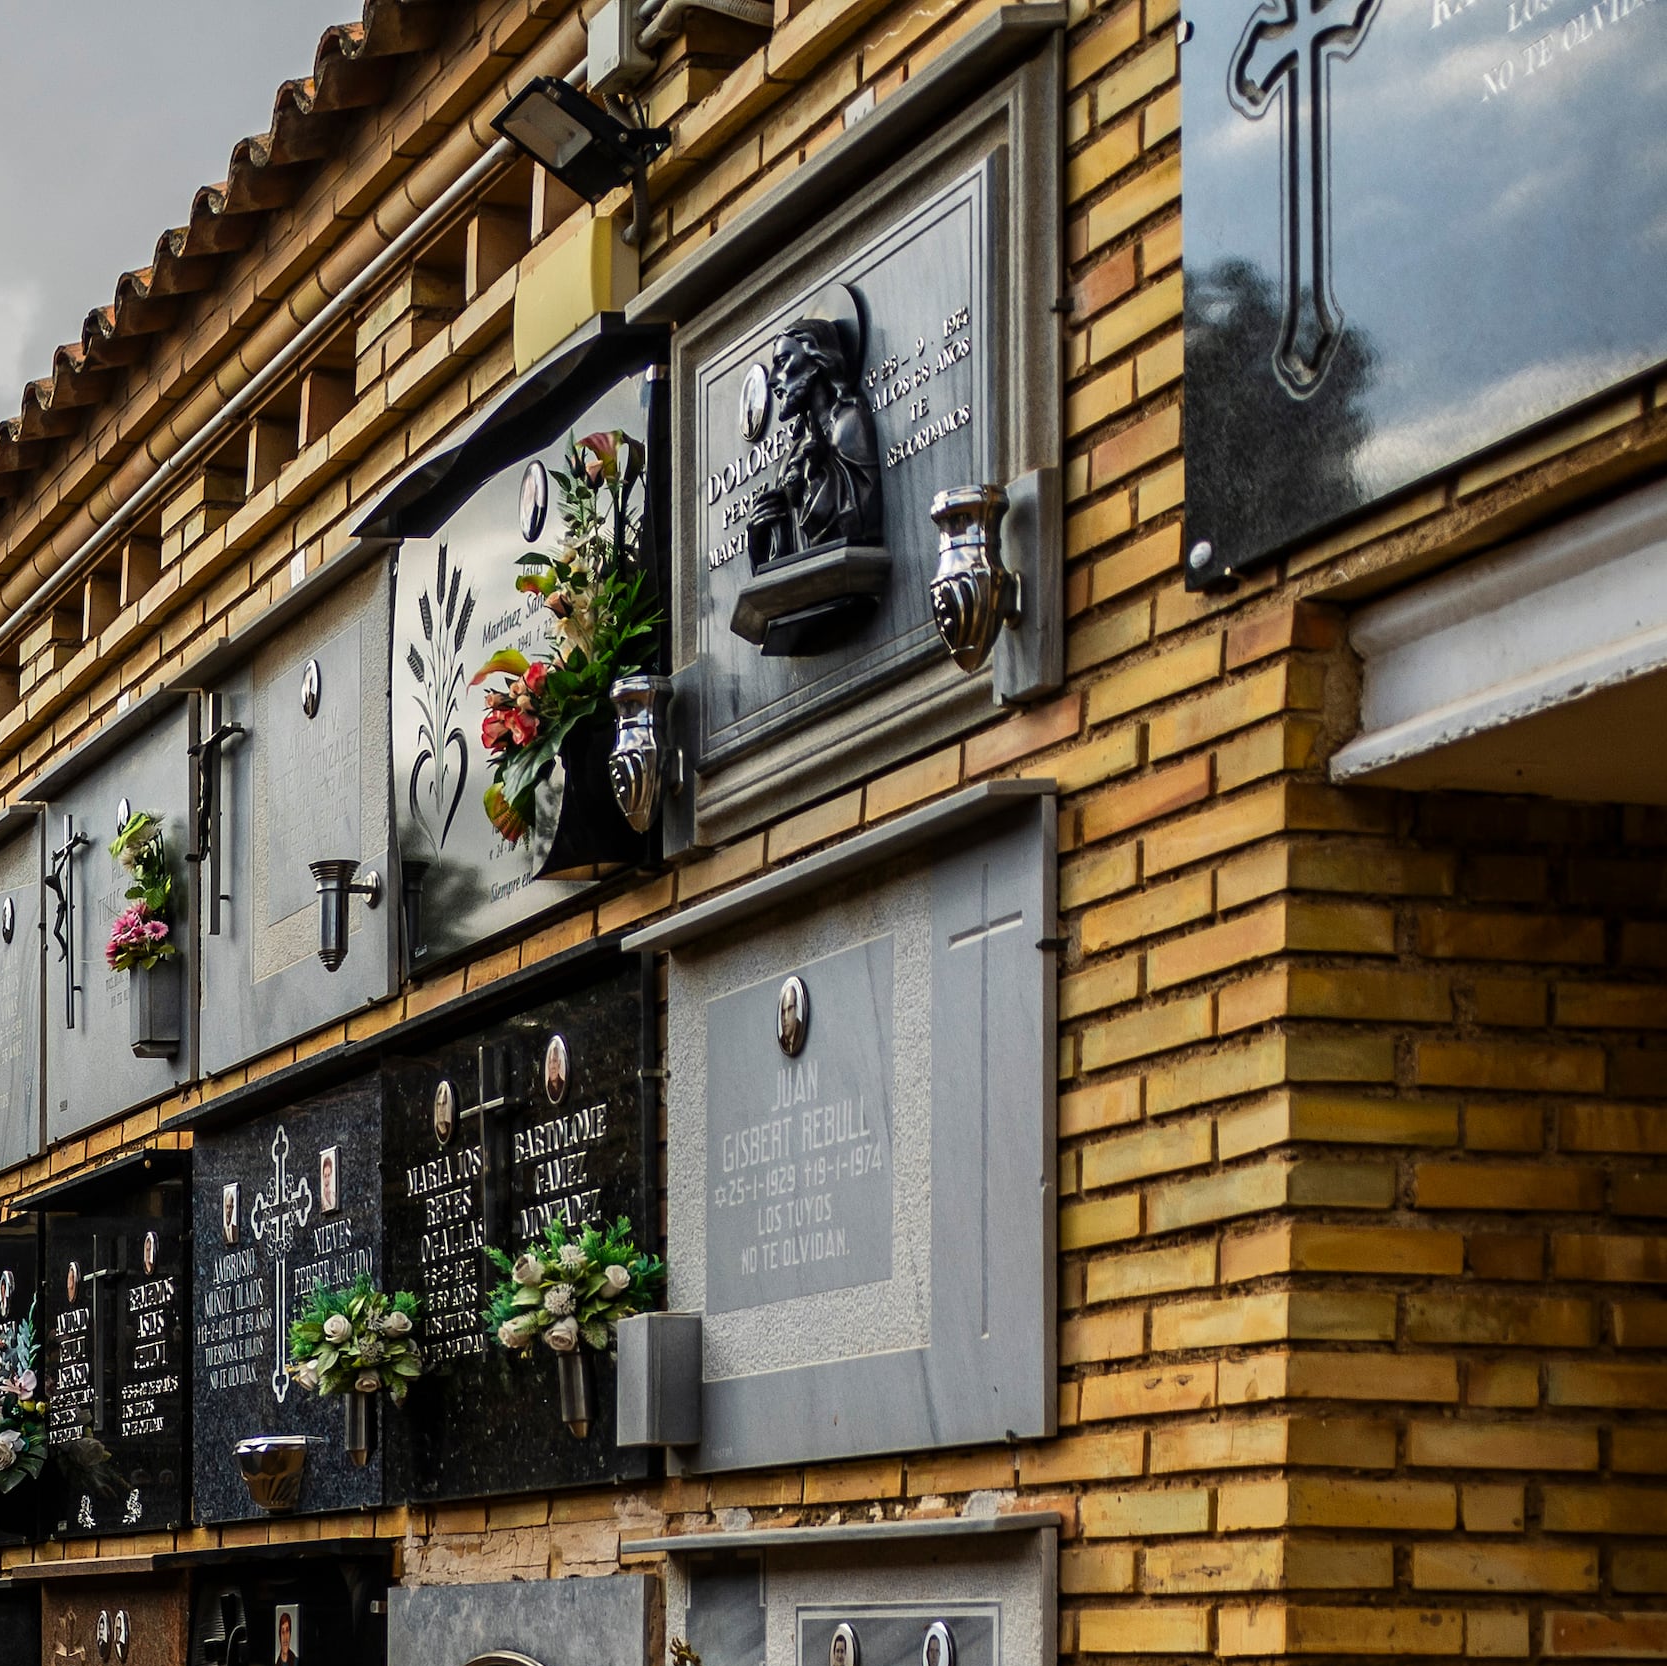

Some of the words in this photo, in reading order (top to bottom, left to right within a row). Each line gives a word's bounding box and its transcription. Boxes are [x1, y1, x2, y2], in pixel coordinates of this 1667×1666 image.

[909, 396, 929, 422] TE
[887, 405, 971, 468] RECORDAMOS
[771, 1060, 818, 1113] JUAN
[722, 1115, 793, 1173] GISBERT
[801, 1095, 870, 1153] REBULL
[425, 1185, 473, 1227] REYES
[757, 1204, 783, 1236] LOS
[786, 1193, 833, 1230] TUYOS
[313, 1218, 353, 1257] NIEVES
[741, 1247, 765, 1276] NO
[762, 1242, 779, 1271] TE
[782, 1227, 851, 1267] OLVIDAN.
[213, 1248, 256, 1285] AMBROSIO
[204, 1286, 233, 1320] MUÑOZ
[235, 1277, 264, 1311] OLMOS
